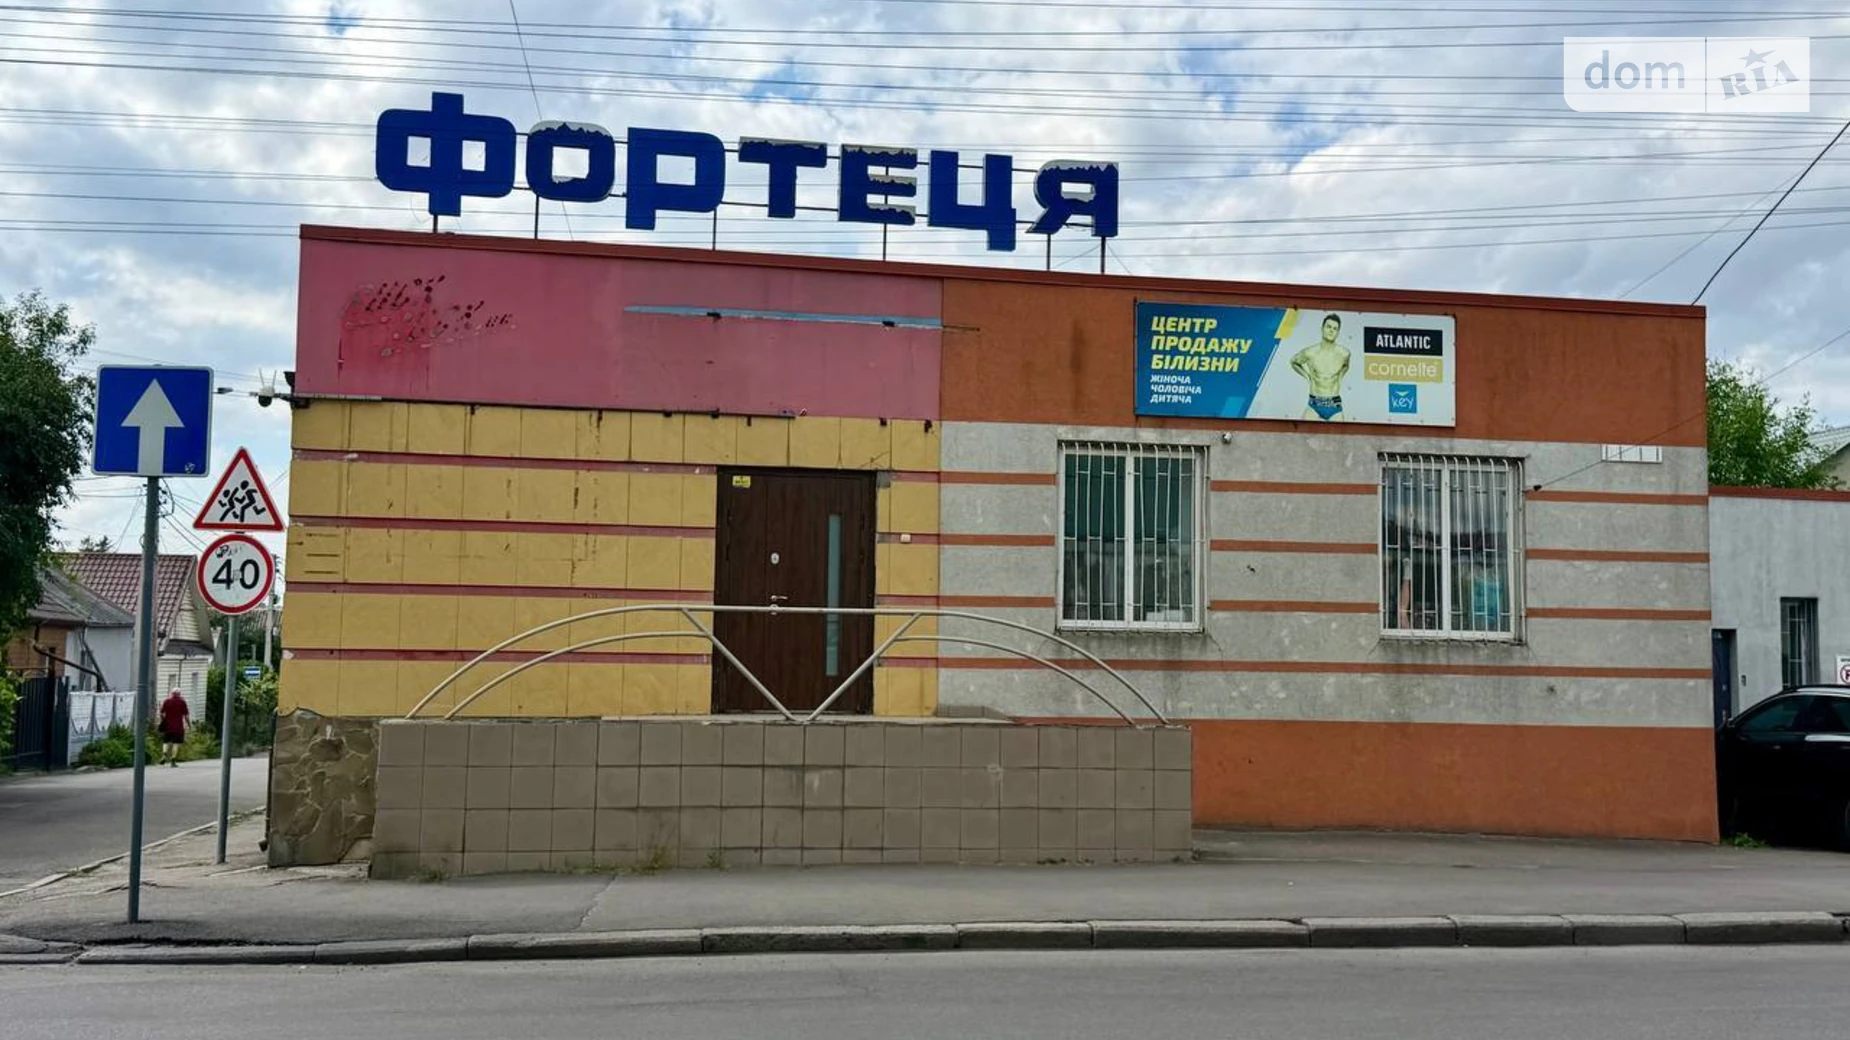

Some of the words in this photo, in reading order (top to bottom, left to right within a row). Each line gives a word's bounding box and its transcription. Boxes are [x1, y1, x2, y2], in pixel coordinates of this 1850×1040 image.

[376, 92, 1119, 251] ФОРТЕЦЯ
[1151, 316, 1218, 334] ЦЕНТР
[1151, 335, 1253, 354] ПРОДАЖУ
[1375, 334, 1431, 350] ATLANTIC
[1151, 354, 1240, 372] БІЛИЗНИ
[1150, 374, 1191, 384] ЖІНОЧА
[1150, 384, 1202, 394] ЧОЛОВІЧА
[1150, 394, 1192, 404] ДИТЯЧА
[212, 558, 260, 590] 40
